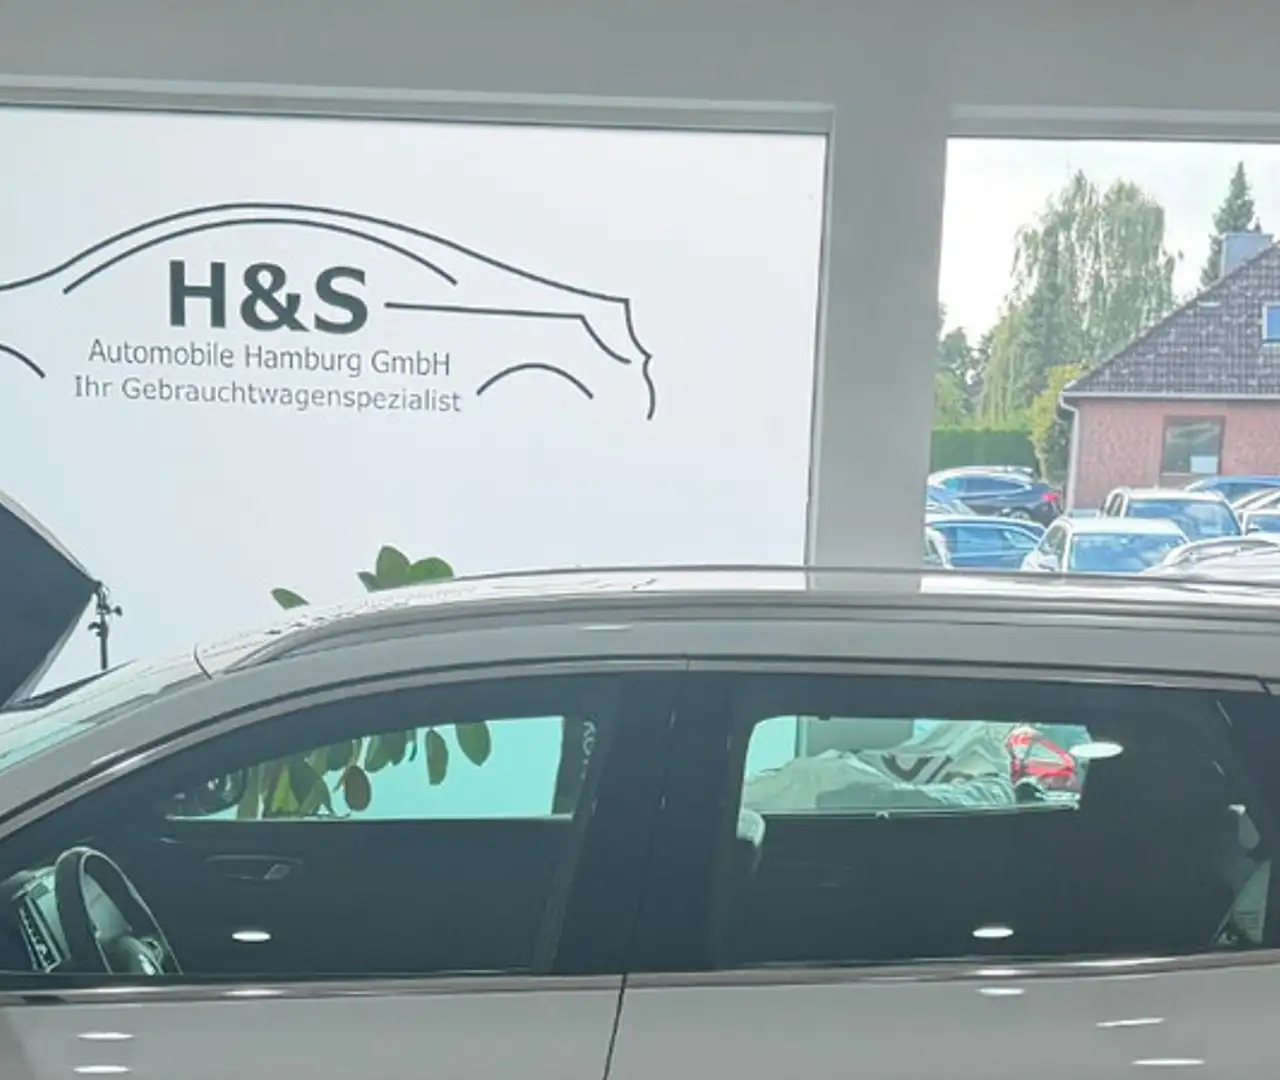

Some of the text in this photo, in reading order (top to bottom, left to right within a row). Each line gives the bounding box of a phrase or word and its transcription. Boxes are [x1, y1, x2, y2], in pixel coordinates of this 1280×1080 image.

[169, 259, 369, 335] H&S
[88, 338, 451, 377] Automobile Hamburg GmbH
[75, 375, 462, 413] Ihr Gebrauchtwagenspezialist
